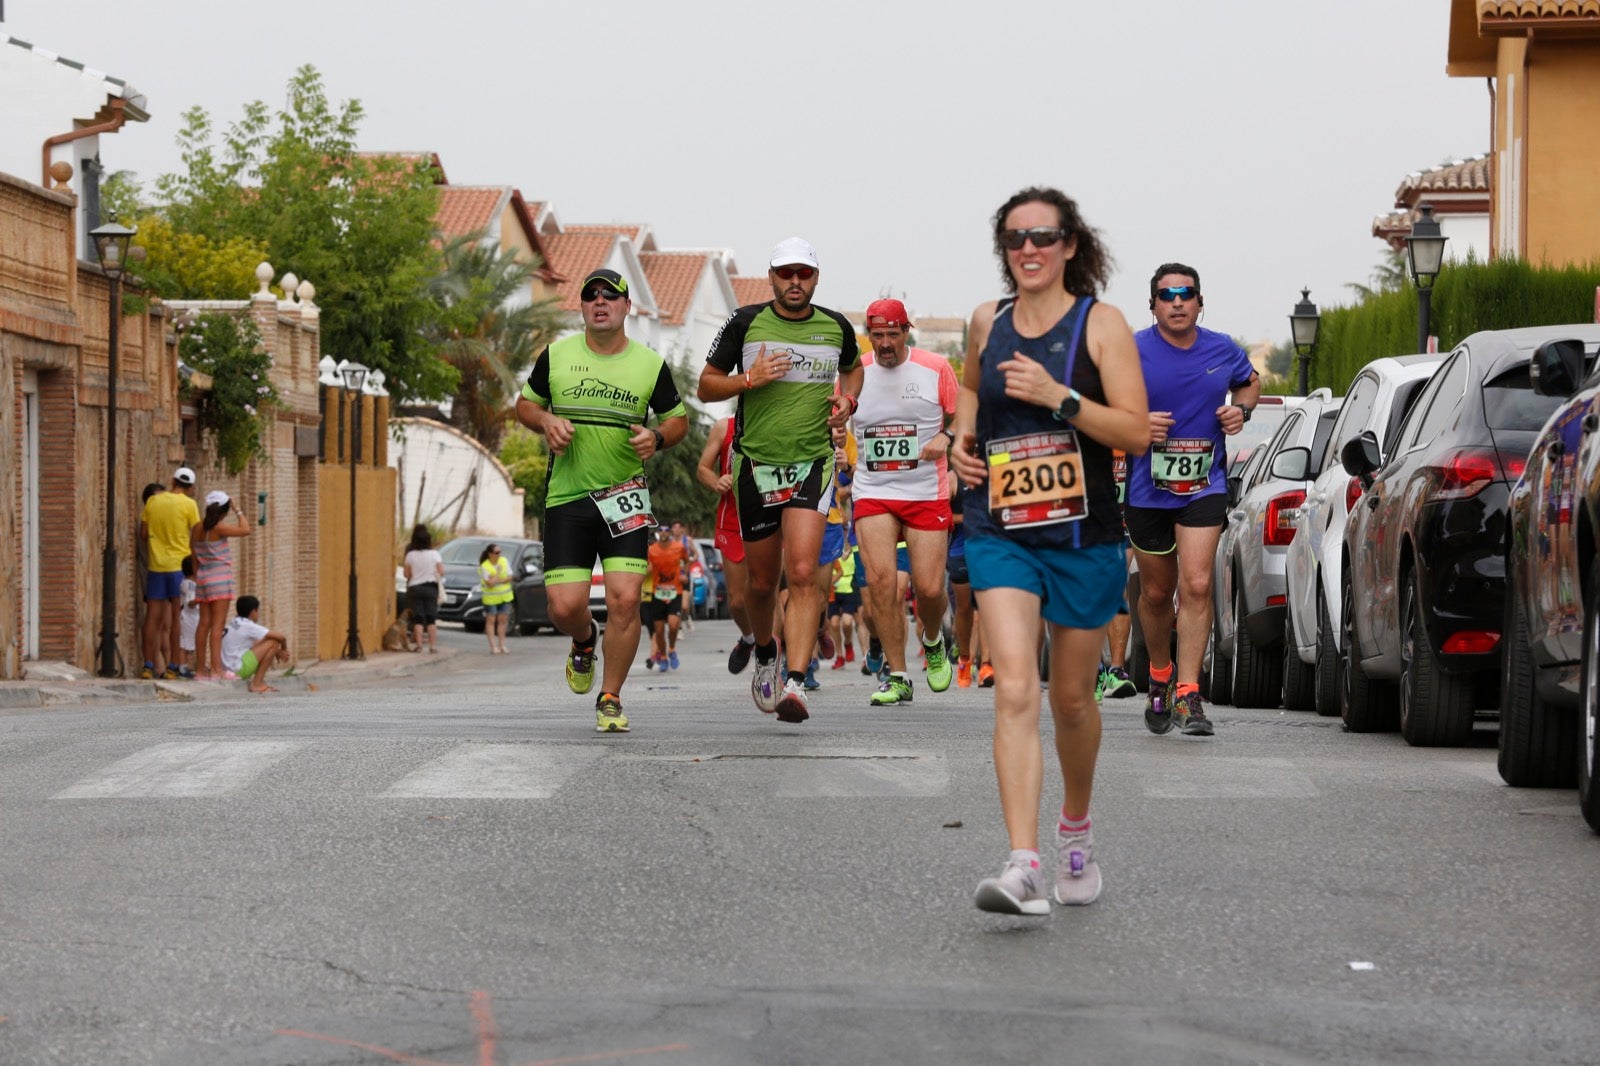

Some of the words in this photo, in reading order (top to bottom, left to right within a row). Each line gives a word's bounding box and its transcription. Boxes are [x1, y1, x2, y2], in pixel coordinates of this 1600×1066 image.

[874, 439, 910, 457] 678
[771, 465, 798, 485] 16
[1163, 456, 1203, 476] 781
[1001, 461, 1076, 498] 2300
[616, 491, 644, 514] 83
